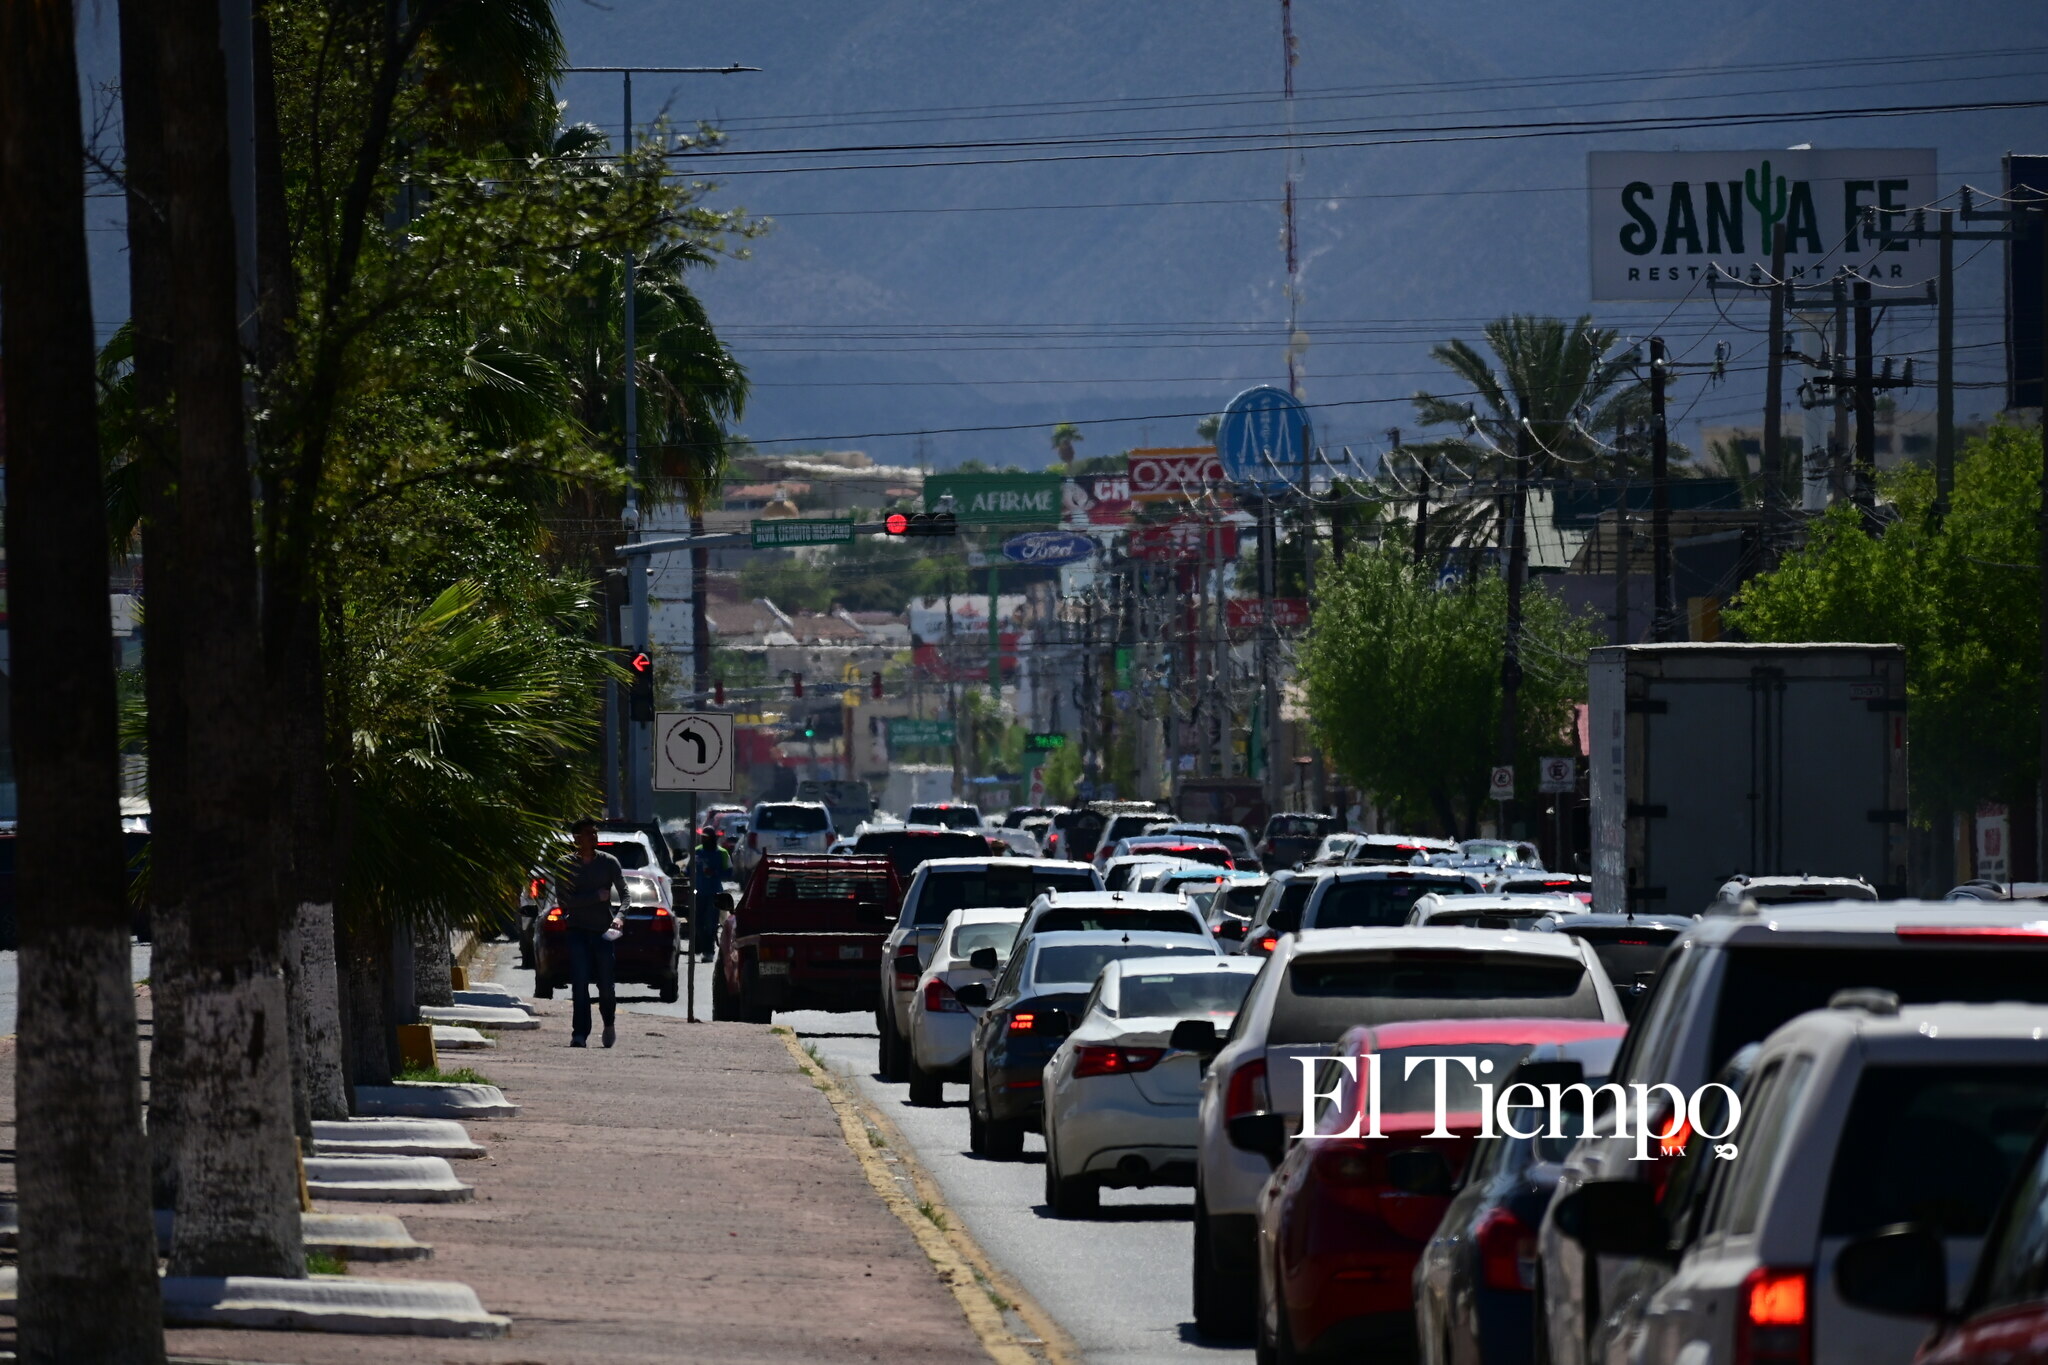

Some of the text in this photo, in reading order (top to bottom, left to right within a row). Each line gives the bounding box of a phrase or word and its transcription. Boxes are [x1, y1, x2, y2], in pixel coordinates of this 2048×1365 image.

[1845, 179, 1910, 254] FE
[1628, 265, 1825, 281] RESTUNT
[1132, 457, 1224, 490] OXXO
[970, 488, 1054, 512] AFIRME
[1021, 535, 1076, 559] Ford
